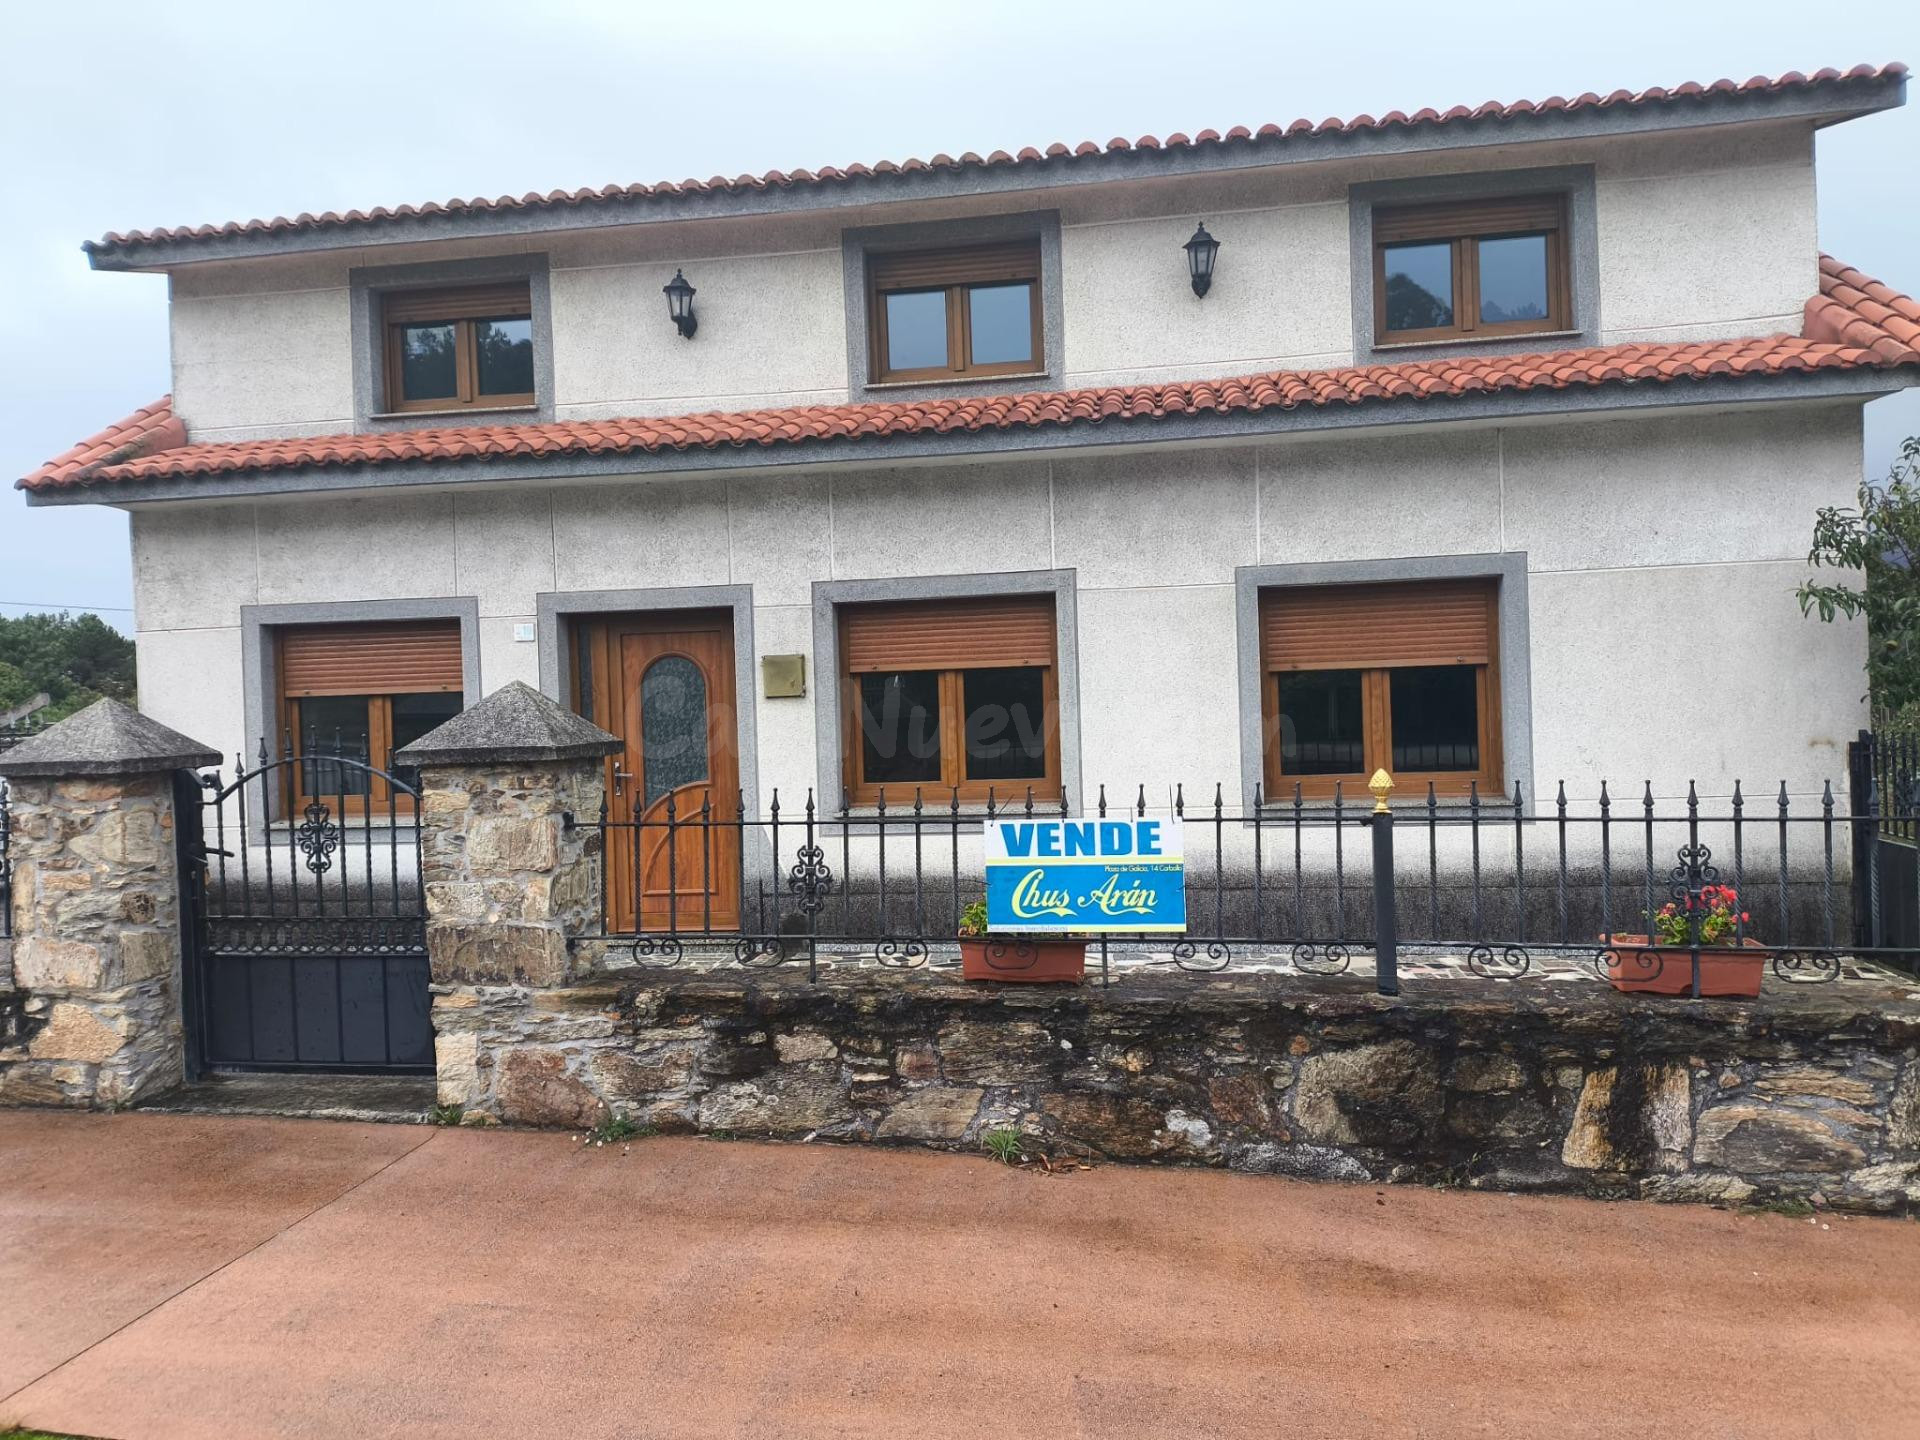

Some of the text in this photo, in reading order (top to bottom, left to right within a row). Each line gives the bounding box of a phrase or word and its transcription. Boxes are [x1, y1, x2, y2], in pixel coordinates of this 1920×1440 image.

[1000, 821, 1162, 857] VENDE
[1011, 868, 1158, 918] Chus Arán
